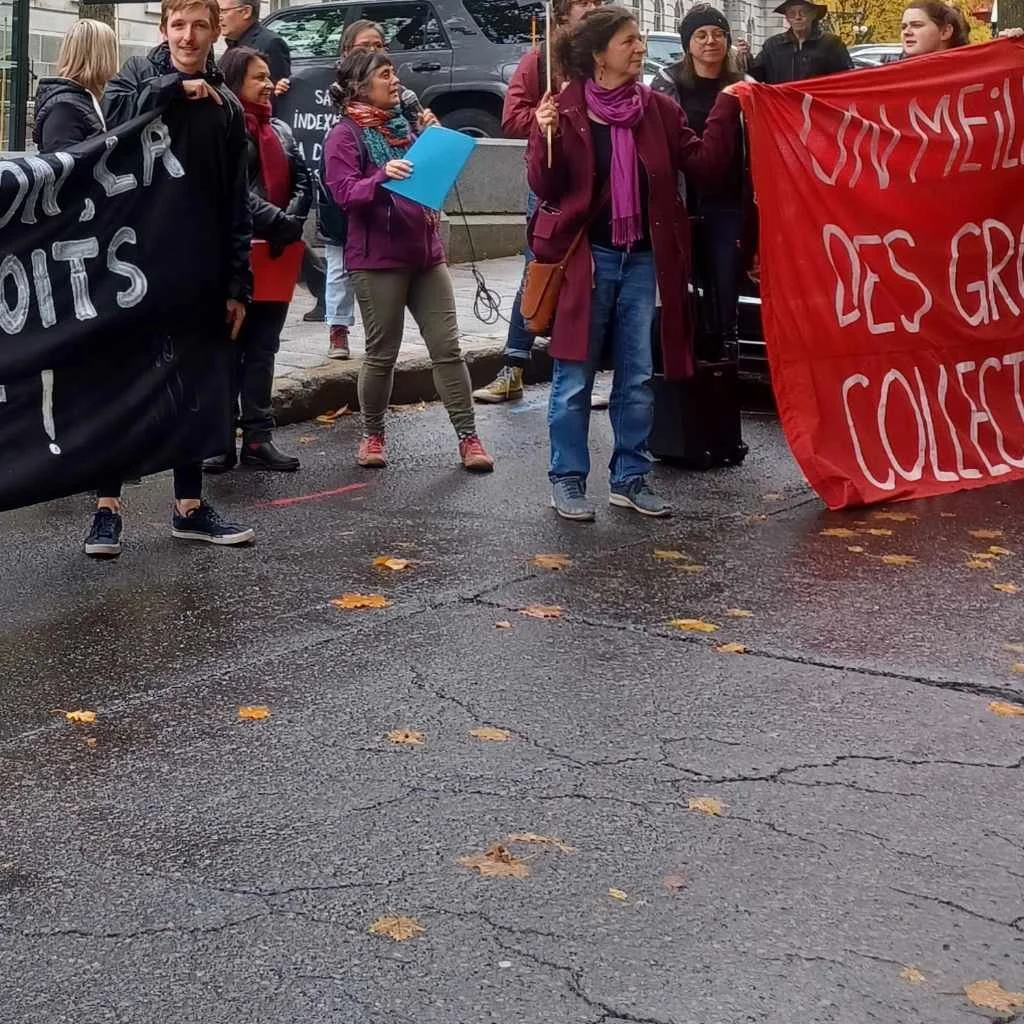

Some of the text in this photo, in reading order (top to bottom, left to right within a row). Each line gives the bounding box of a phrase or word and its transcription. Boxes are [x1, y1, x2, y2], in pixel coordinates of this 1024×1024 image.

[93, 117, 186, 197] LA
[800, 93, 901, 189] UN
[822, 218, 1024, 335] DES GR
